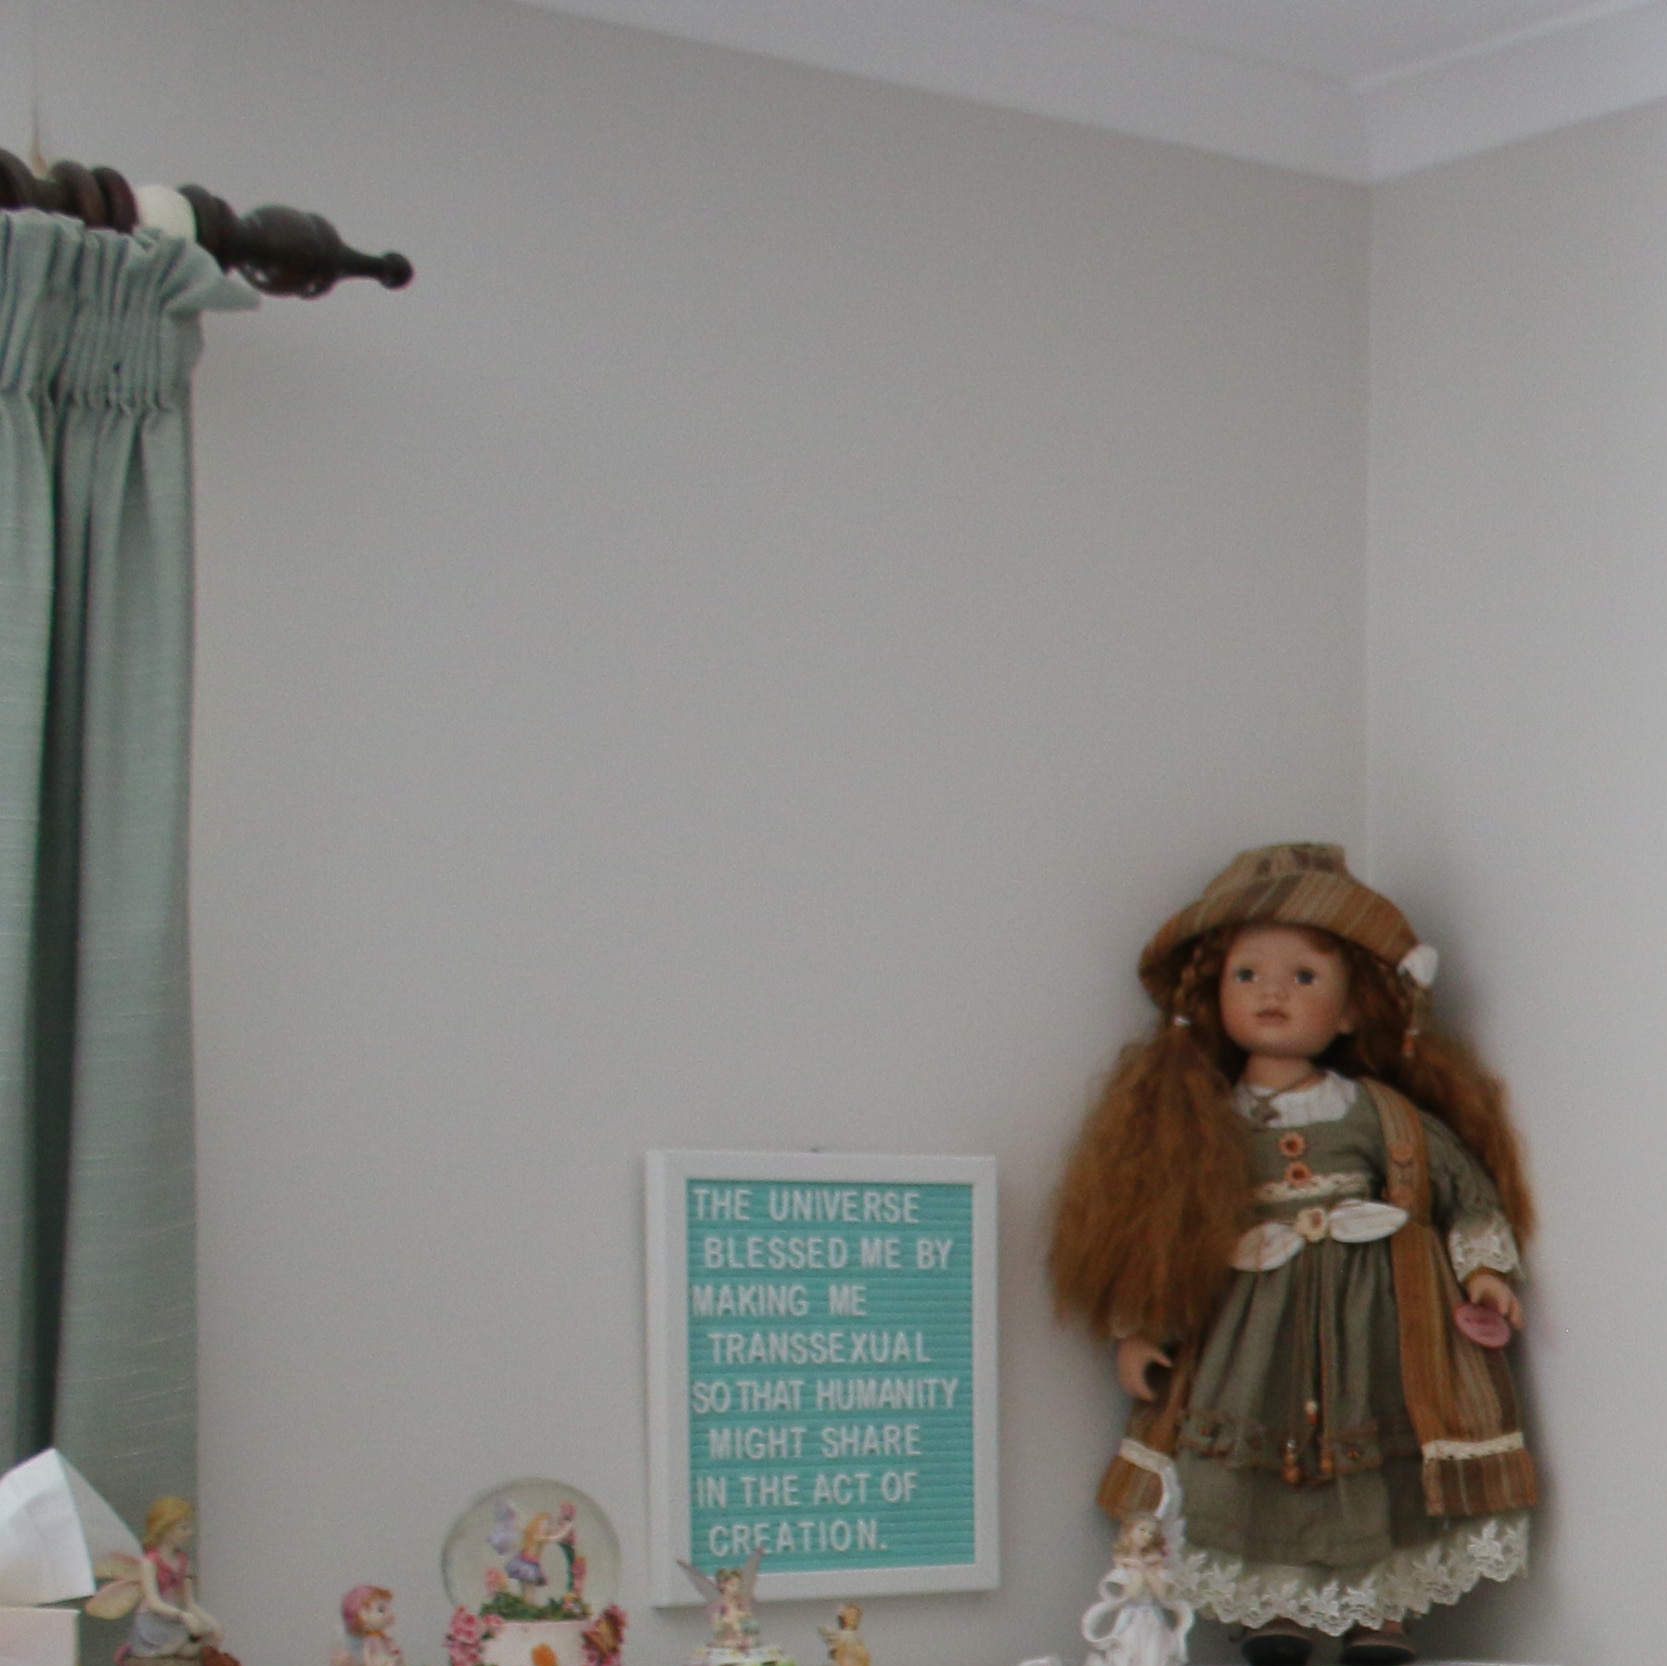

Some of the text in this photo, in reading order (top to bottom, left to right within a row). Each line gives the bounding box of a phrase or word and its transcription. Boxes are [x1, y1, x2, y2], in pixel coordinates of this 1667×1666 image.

[692, 1188, 920, 1225] THE UNIVERSE
[703, 1236, 953, 1271] BLESSED ME BY
[691, 1283, 868, 1318] MAKING ME
[707, 1330, 933, 1365] TRANSSEXUAL
[690, 1377, 959, 1415] SO THAT HUMANITY
[707, 1424, 922, 1460] MIGHT SHARE
[696, 1471, 919, 1509] IN THE ACT OF
[708, 1519, 888, 1558] CREATION.
